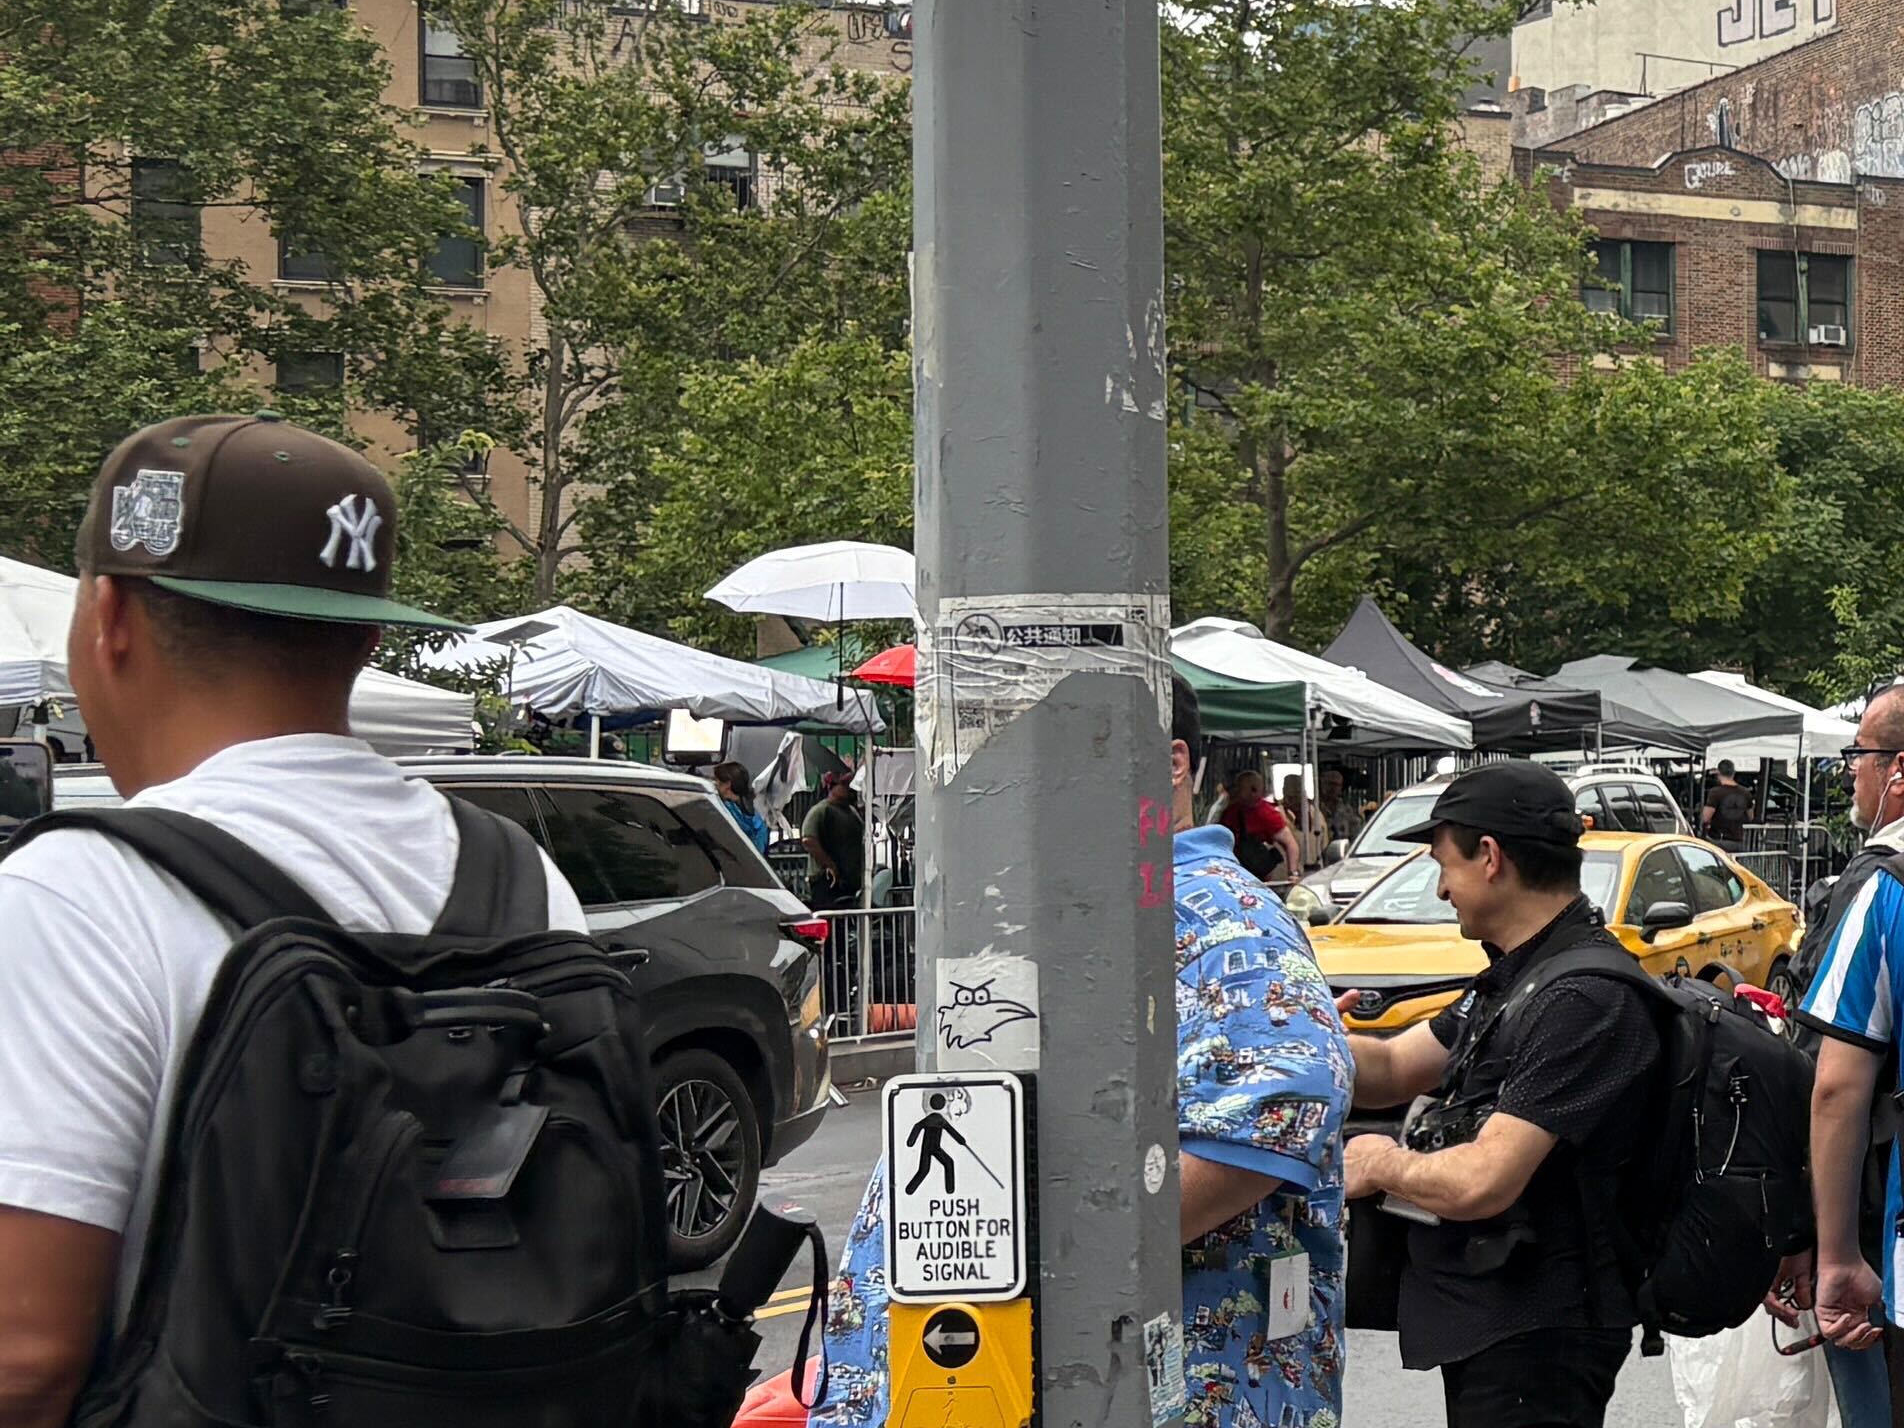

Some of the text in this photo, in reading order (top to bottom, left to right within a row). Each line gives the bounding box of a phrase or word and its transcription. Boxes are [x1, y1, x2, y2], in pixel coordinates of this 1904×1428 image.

[929, 1198, 980, 1217] PUSH
[899, 1218, 1011, 1240] BUTTON FOR
[916, 1240, 997, 1260] AUDIBLE
[922, 1262, 991, 1282] SIGNAL
